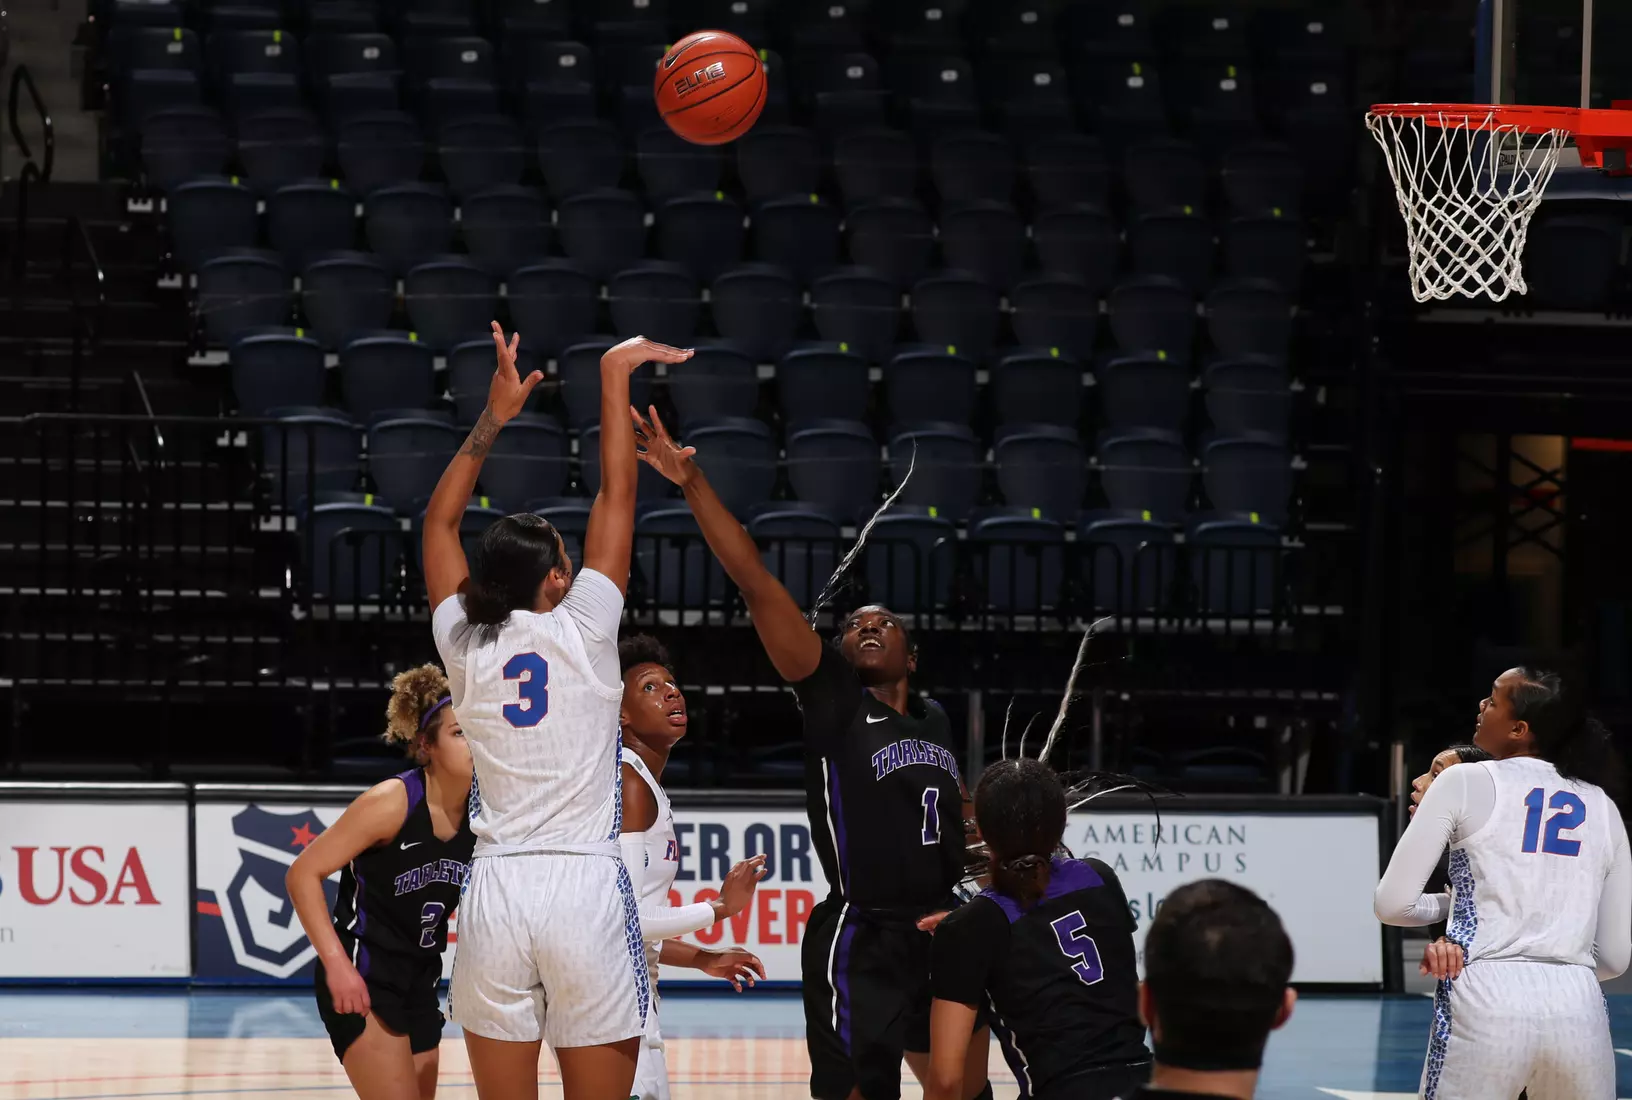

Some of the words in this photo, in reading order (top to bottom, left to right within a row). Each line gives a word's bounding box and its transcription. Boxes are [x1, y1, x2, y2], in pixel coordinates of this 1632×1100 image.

[674, 61, 726, 96] ELITE
[502, 652, 549, 729] 3
[872, 737, 961, 789] TARLETO
[921, 787, 942, 845] 1
[1084, 824, 1246, 845] AMERICAN
[1521, 786, 1587, 857] 12
[12, 845, 161, 906] USA
[744, 823, 812, 882] OR
[419, 901, 446, 948] 2
[1050, 909, 1104, 985] 5
